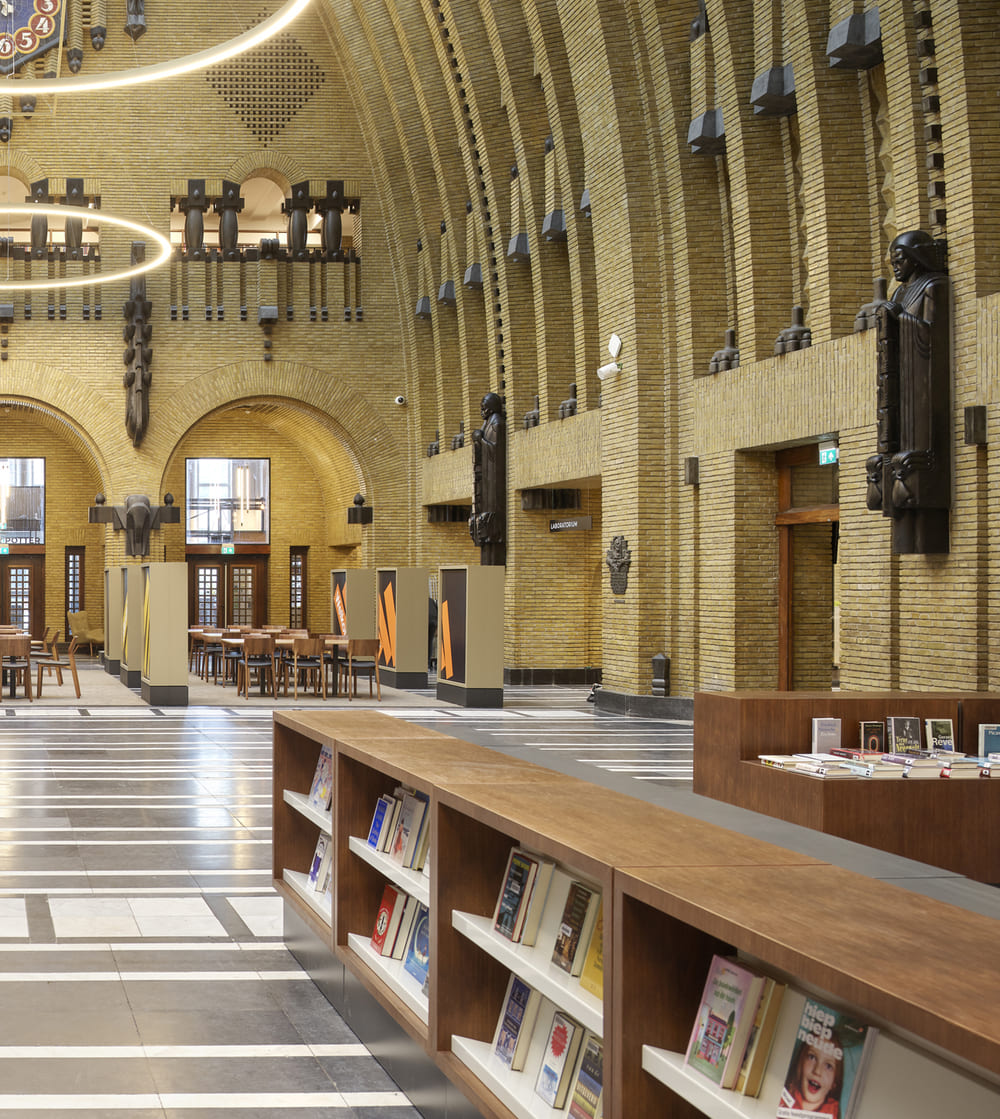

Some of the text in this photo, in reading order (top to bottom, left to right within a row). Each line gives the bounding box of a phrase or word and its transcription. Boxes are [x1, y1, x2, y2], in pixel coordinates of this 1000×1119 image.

[35, 17, 50, 33] 4
[20, 32, 32, 48] 5
[550, 521, 578, 530] LABORATORIUM
[804, 1001, 836, 1028] hiep
[801, 1014, 833, 1040] biep
